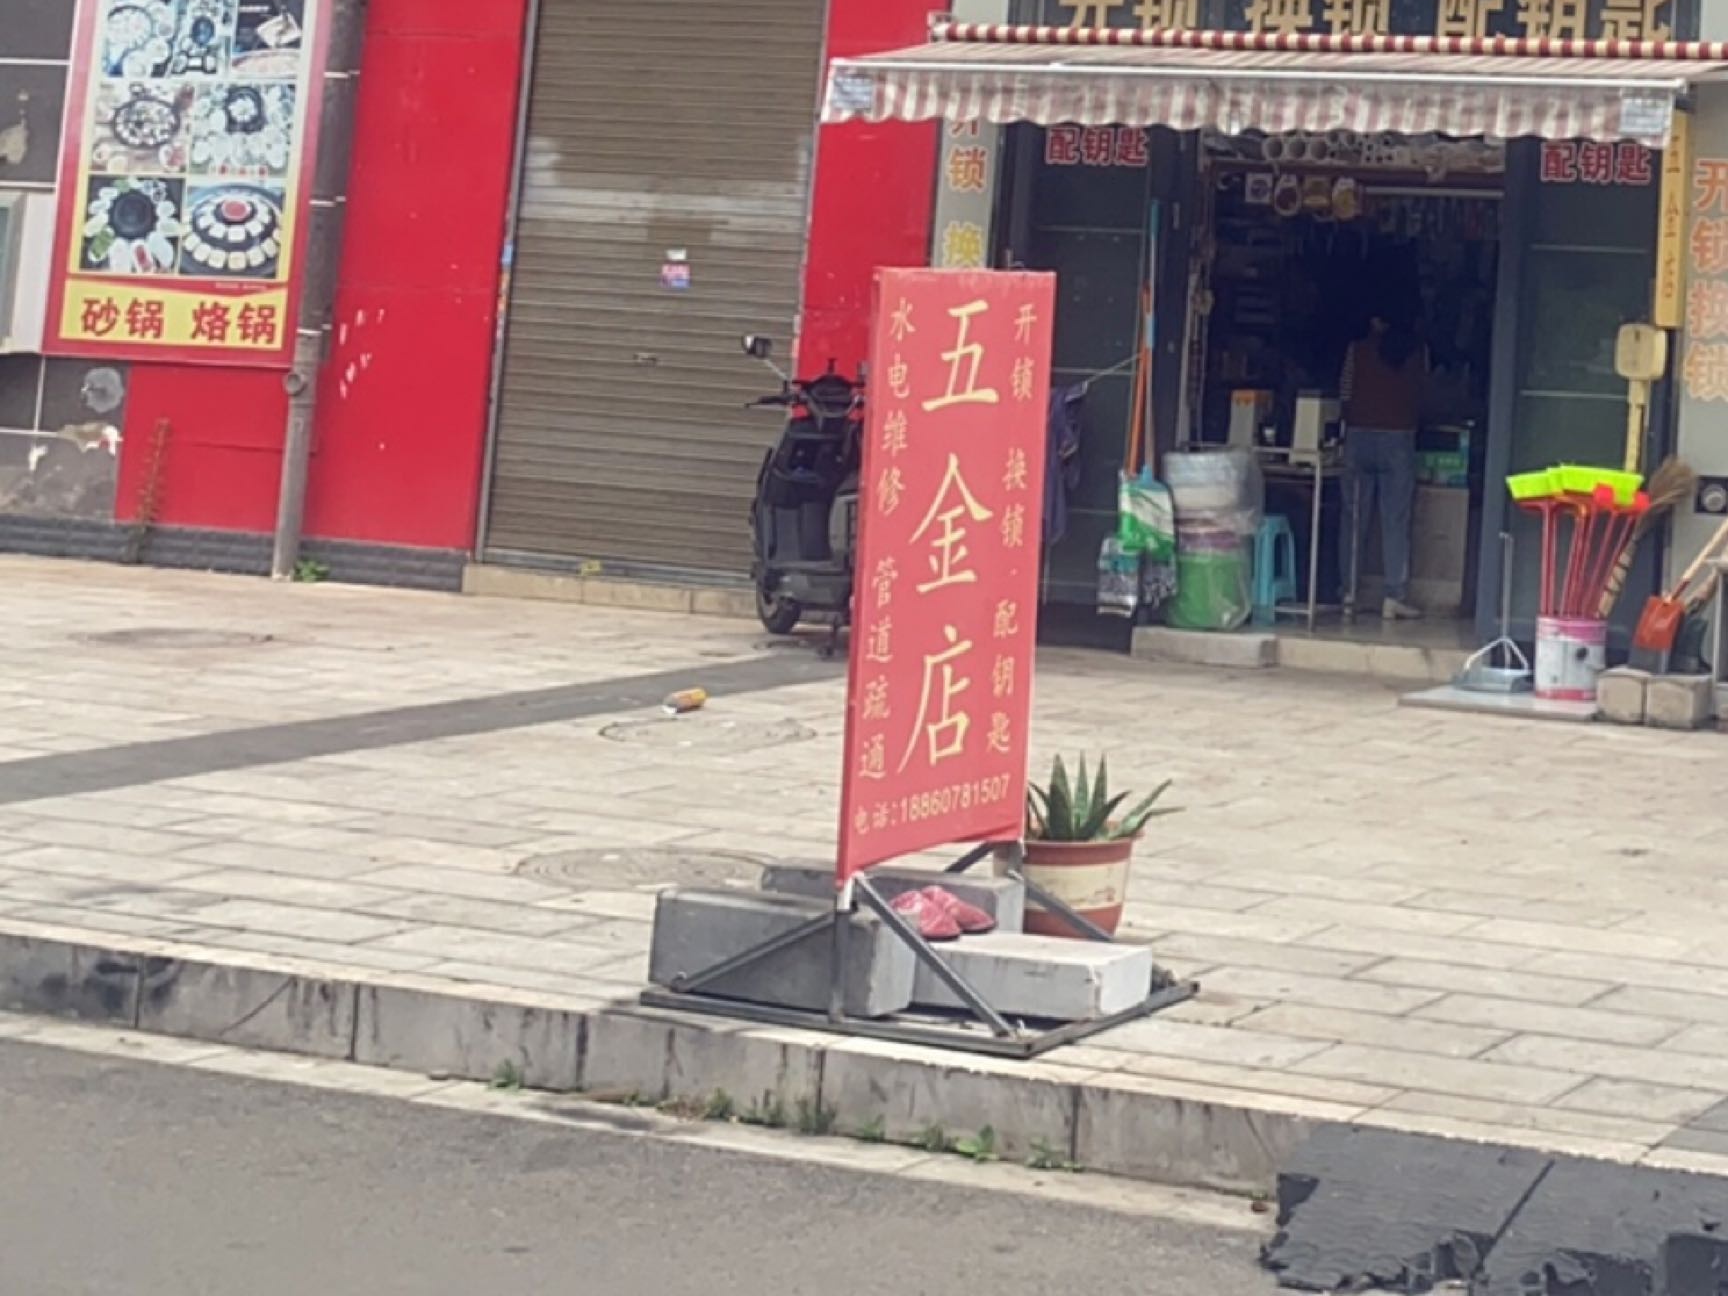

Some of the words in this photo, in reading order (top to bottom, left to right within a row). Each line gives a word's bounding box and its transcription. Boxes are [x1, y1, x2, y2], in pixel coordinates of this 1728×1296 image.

[1046, 126, 1149, 165] 配钥匙
[1540, 141, 1652, 183] 配钥匙
[81, 296, 164, 340] 砂锅
[190, 300, 277, 345] 烙锅
[1010, 304, 1038, 402] 开锁
[875, 296, 917, 516] 水电维修
[897, 299, 999, 775] 五金店
[999, 447, 1029, 548] 换锁
[857, 557, 900, 781] 管道疏通
[985, 599, 1020, 756] 配钥匙
[853, 773, 1011, 836] 电话:18860781507
